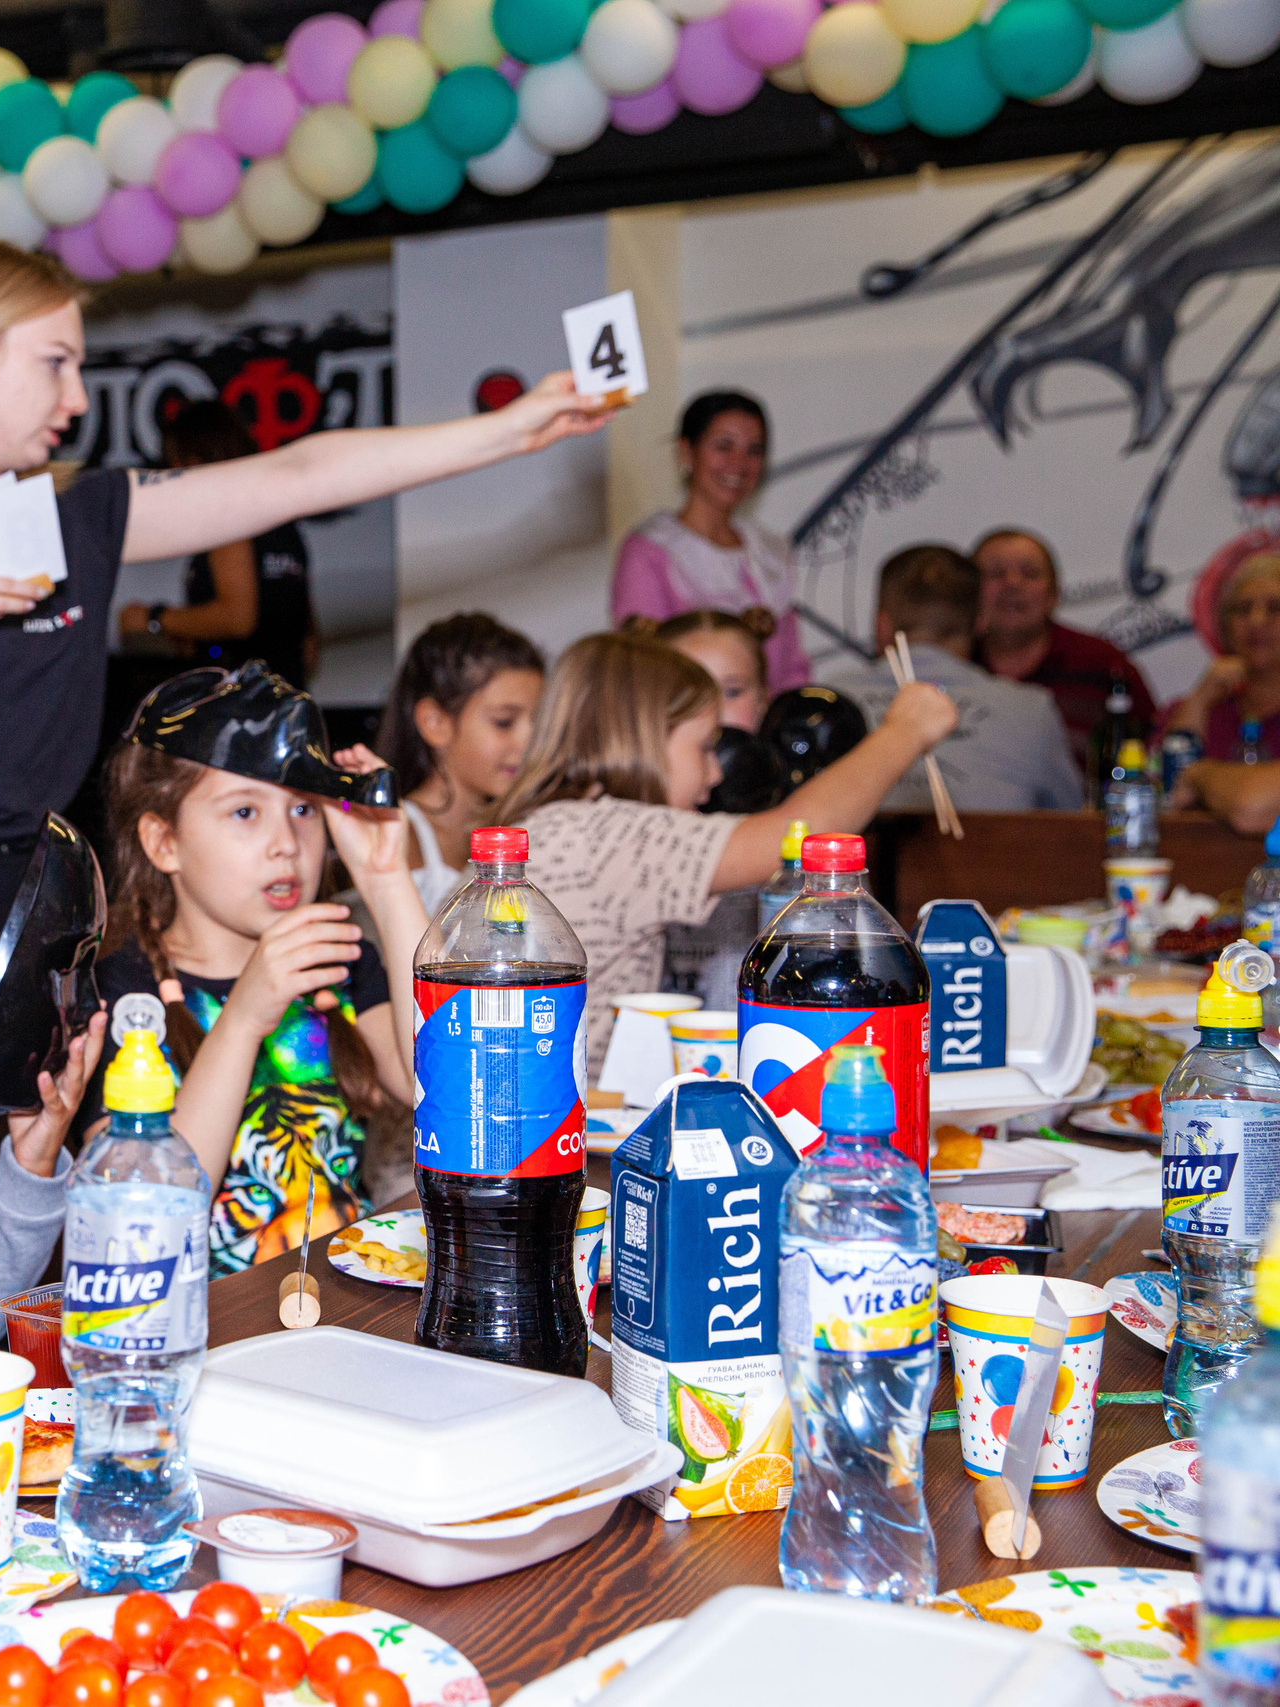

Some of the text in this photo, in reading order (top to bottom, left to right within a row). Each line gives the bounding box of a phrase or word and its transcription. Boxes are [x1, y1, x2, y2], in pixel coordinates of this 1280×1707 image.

[591, 324, 626, 378] 4
[447, 1022, 461, 1036] 1,5
[535, 1013, 552, 1025] 45,0
[942, 966, 982, 1067] Rich
[414, 1127, 440, 1154] OLA
[557, 1129, 586, 1156] COO
[707, 1183, 762, 1348] Rich
[844, 1292, 884, 1315] Vit
[889, 1289, 906, 1311] &
[911, 1283, 933, 1305] Go
[697, 1370, 777, 1383] АПЕЛЬСИН, ЯБЛОКО
[708, 1362, 766, 1374] ГУАВА, БАНАН,
